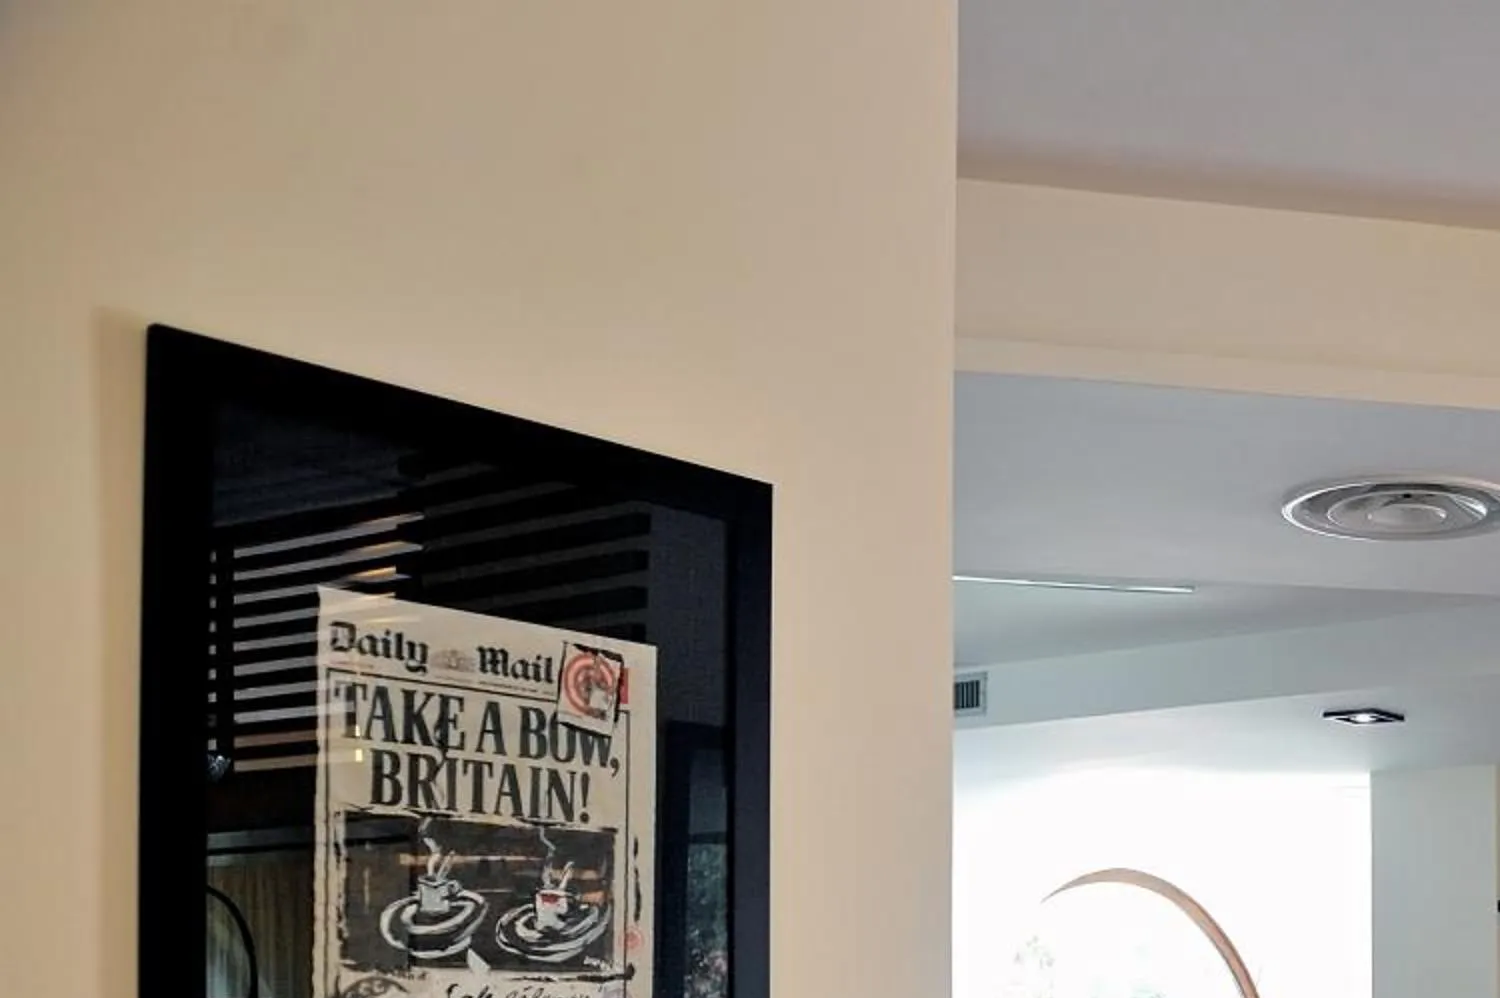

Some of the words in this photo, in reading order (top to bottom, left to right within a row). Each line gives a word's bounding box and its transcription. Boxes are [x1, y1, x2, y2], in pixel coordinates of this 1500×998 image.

[329, 621, 429, 674] Daily
[476, 647, 553, 683] Mail
[335, 681, 465, 750] TAKE
[476, 701, 507, 756] A
[370, 749, 590, 823] BRITAIN!
